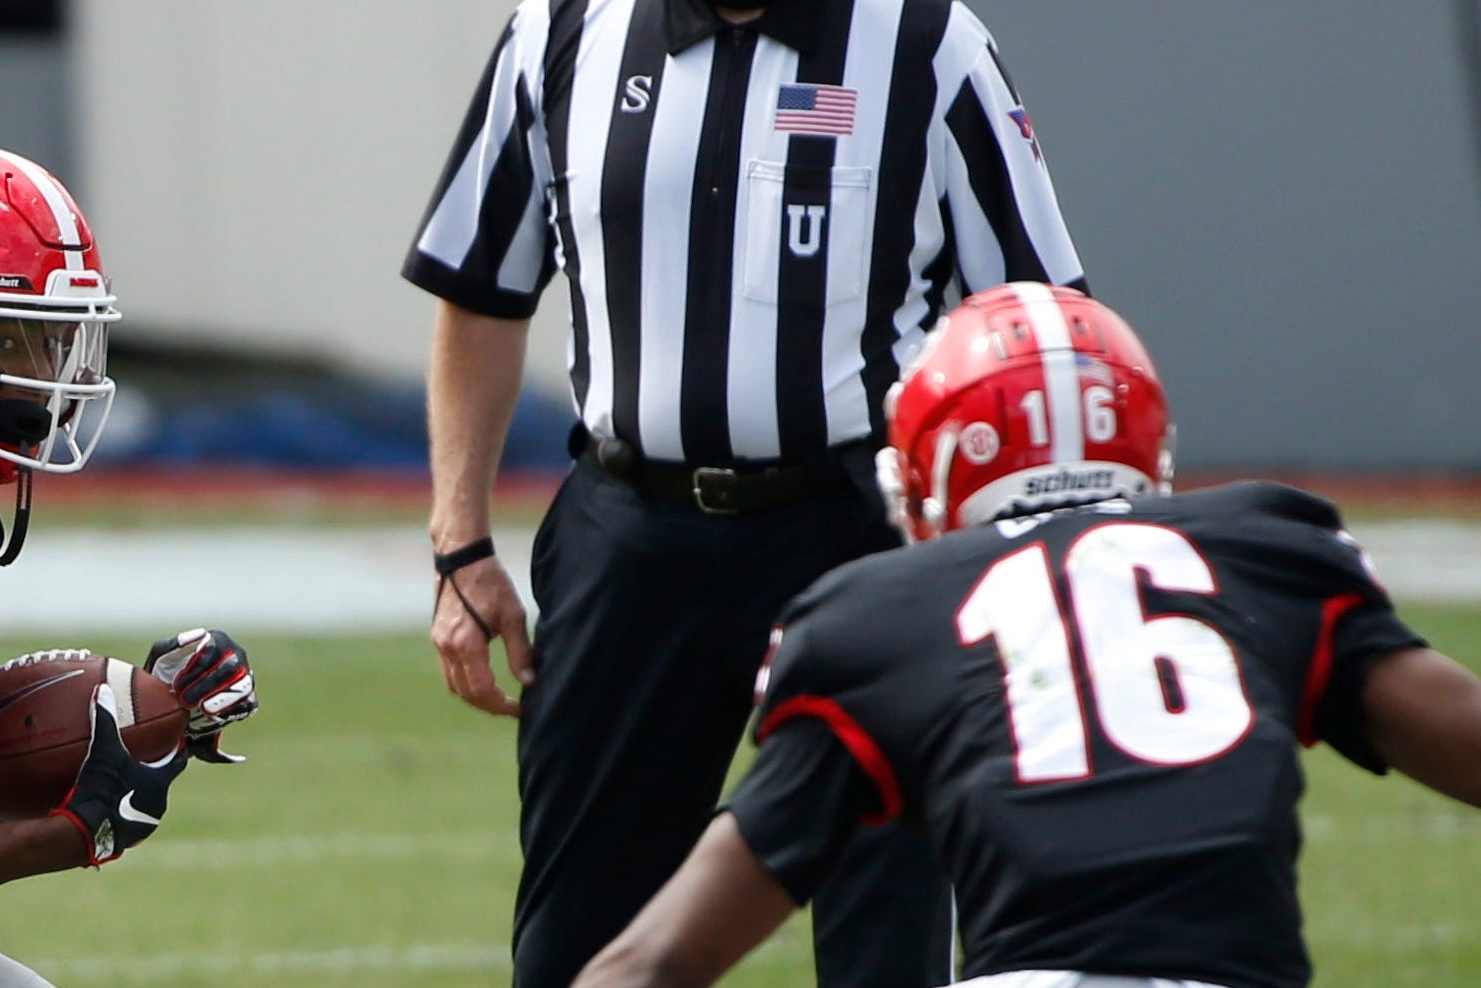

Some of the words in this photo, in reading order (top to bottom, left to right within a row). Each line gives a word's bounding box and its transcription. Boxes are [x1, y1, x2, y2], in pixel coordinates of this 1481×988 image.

[621, 75, 652, 112] S
[787, 204, 825, 256] U
[1021, 385, 1117, 446] 16
[953, 520, 1257, 785] 16
